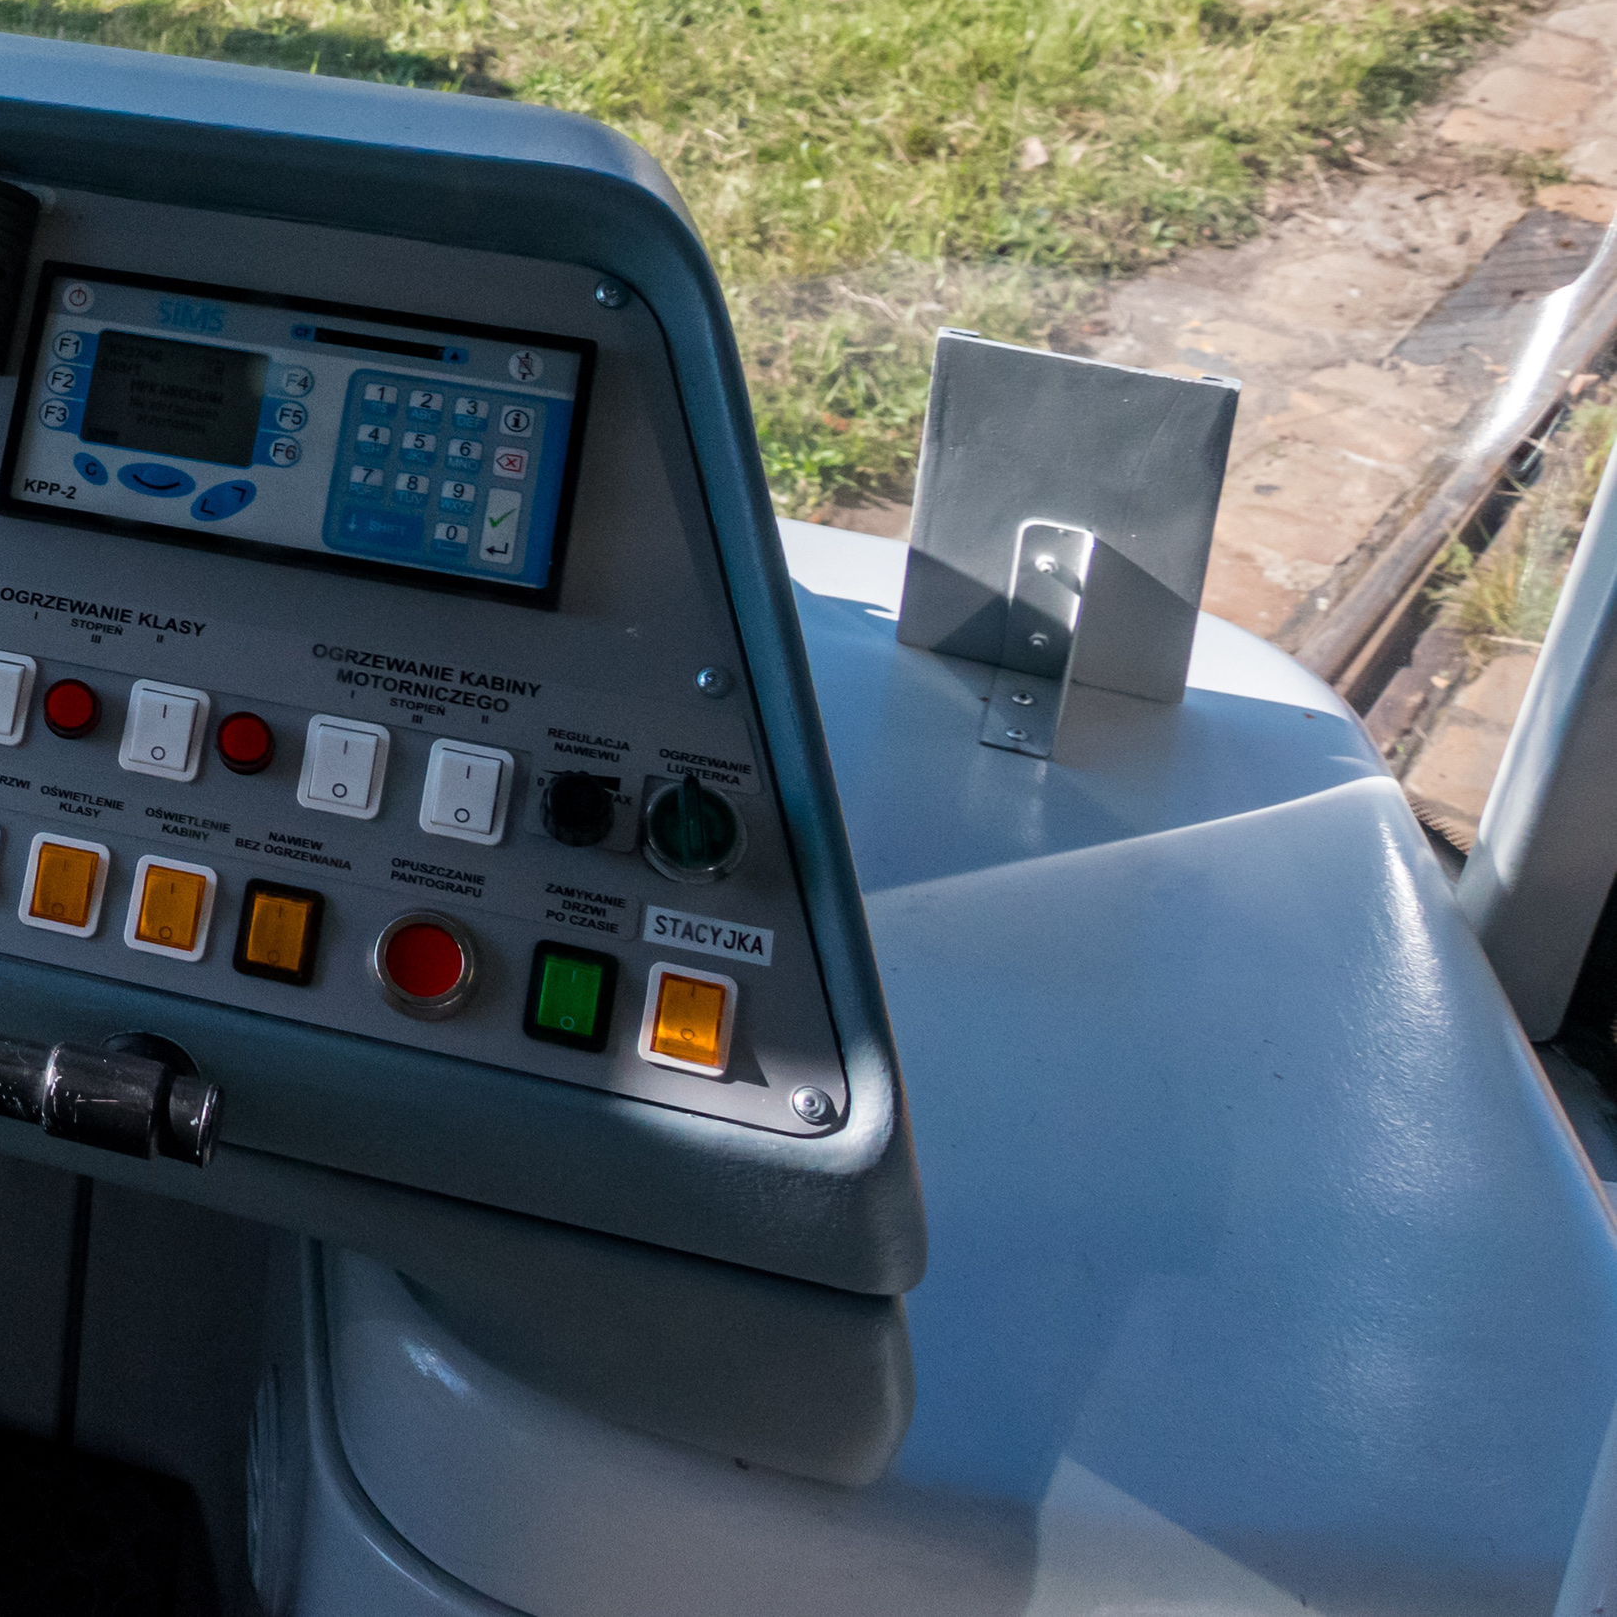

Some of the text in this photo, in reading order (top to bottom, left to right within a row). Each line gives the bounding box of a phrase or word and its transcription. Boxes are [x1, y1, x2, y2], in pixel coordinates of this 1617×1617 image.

[58, 339, 81, 355] F1
[51, 372, 75, 389] F2
[285, 374, 309, 392] F4
[378, 387, 385, 401] 1
[420, 393, 433, 408] 2
[44, 405, 67, 422] F3
[279, 407, 303, 426] F5
[411, 410, 438, 422] ABC
[466, 400, 478, 415] 3
[457, 415, 483, 426] DEF
[368, 428, 380, 441] 4
[414, 434, 426, 449] 5
[272, 442, 297, 462] F6
[460, 442, 471, 456] 6
[85, 462, 97, 476] C
[363, 468, 374, 482] 7
[24, 478, 77, 500] KPP-2
[407, 476, 418, 491] 8
[453, 483, 465, 498] 9
[446, 525, 458, 540] 0
[0, 586, 207, 638] OGRZEWANIE KLASY
[70, 617, 124, 637] STOPIEŃ
[90, 633, 102, 644] III
[156, 633, 164, 643] II
[311, 643, 542, 700] OGRZEWANIE KABINY
[336, 668, 510, 714] MOTORNICZEGO
[389, 697, 447, 717] STOPIEŃ
[411, 714, 423, 725] III
[481, 714, 489, 724] II
[548, 727, 631, 753] REGULACJA
[553, 741, 622, 764] NAWIEWU
[659, 747, 753, 776] OGRZEWANIE
[537, 777, 545, 786] 0
[666, 762, 742, 788] LUSTERKA
[39, 783, 125, 812] OŚWIETLENIE
[58, 801, 102, 820] KLASY
[144, 805, 232, 835] OŚWIETLENIE
[160, 822, 211, 843] KABINY
[267, 830, 323, 853] NAWIEW
[234, 836, 352, 872] BEZ OGRZEWANIA
[391, 856, 486, 886] OPUSZCZANIE
[390, 870, 483, 900] PANTOGRAFU
[545, 882, 627, 910] ZAMYKANIE
[561, 899, 608, 918] DRZWI
[545, 910, 620, 935] PO CZASIE
[652, 913, 765, 957] STACYJKA
